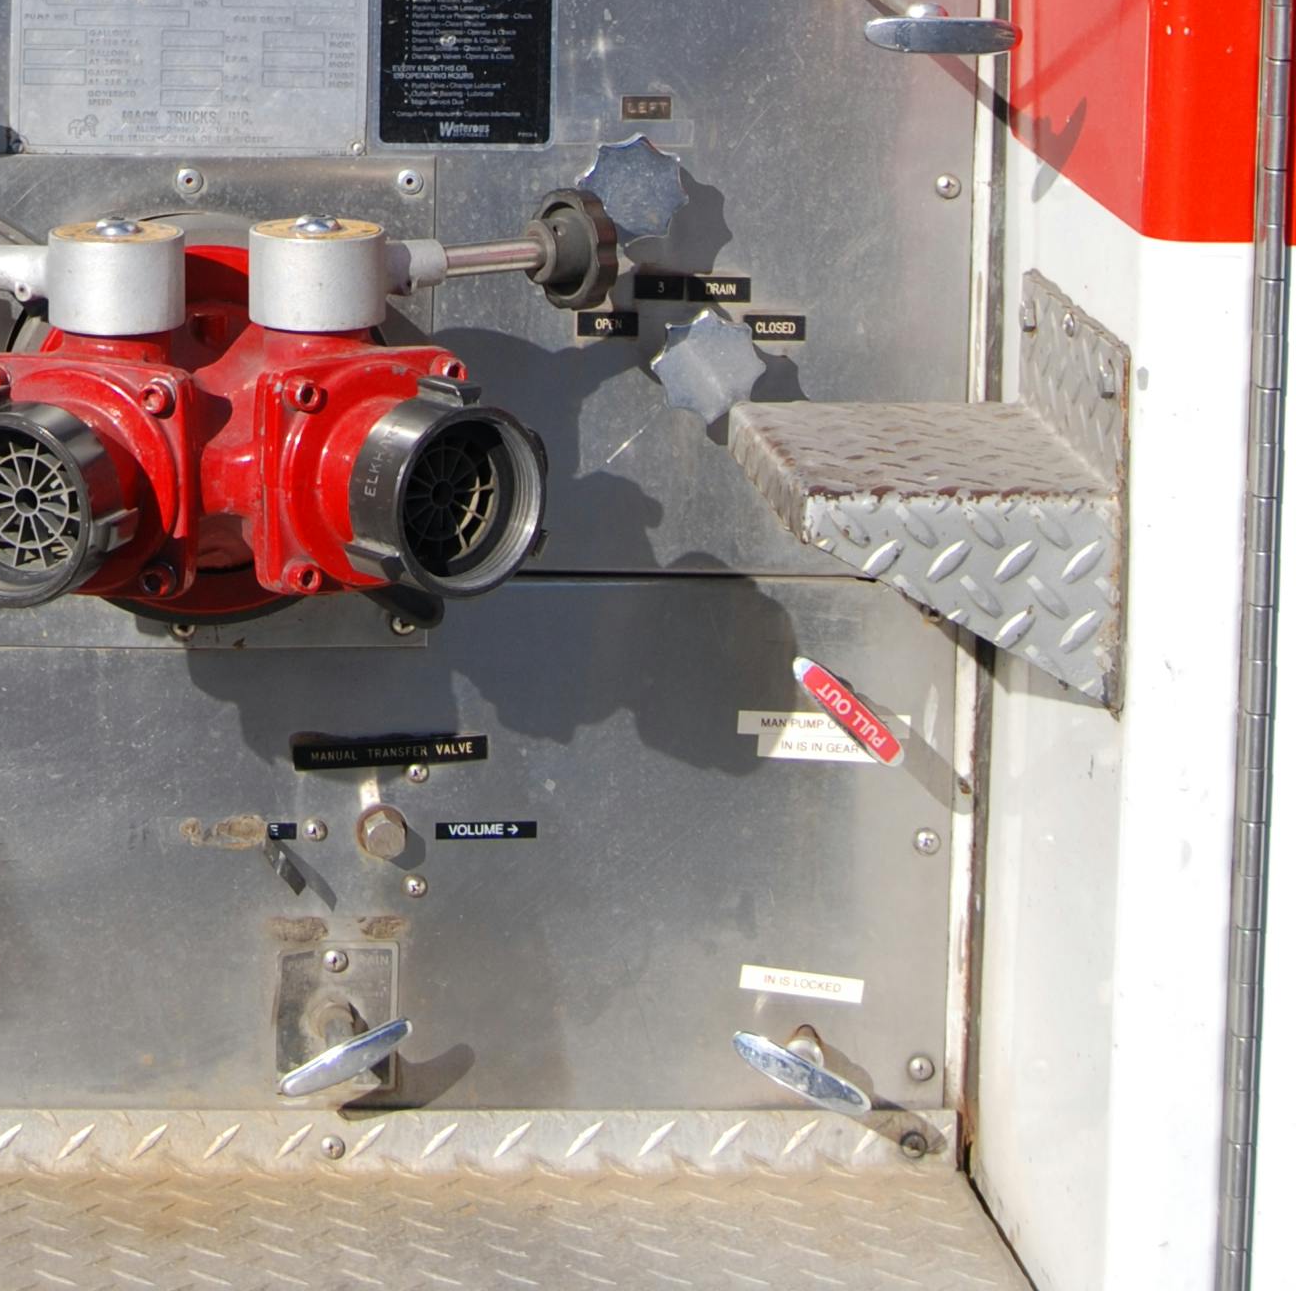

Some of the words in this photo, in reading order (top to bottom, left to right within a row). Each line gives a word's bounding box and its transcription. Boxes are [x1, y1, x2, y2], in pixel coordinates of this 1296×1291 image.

[626, 103, 668, 114] LEFT
[440, 122, 489, 137] Waterous
[657, 281, 664, 292] 3
[706, 283, 736, 295] DRAIN
[595, 320, 622, 329] OPEN
[756, 322, 795, 333] CLOSED
[816, 683, 852, 715] OUT
[761, 719, 787, 727] MAN
[791, 719, 824, 729] PUMP
[853, 711, 886, 749] PULL
[311, 751, 356, 761] MANUAL
[368, 746, 427, 758] TRANSFER
[436, 742, 473, 756] VALVE
[781, 740, 793, 750] IN
[797, 741, 807, 751] IS
[811, 743, 823, 752] IN
[826, 744, 858, 753] GEAR
[448, 824, 504, 836] VOLUME
[764, 974, 775, 985] IN
[779, 976, 790, 986] IS
[794, 978, 841, 993] LOCKED
